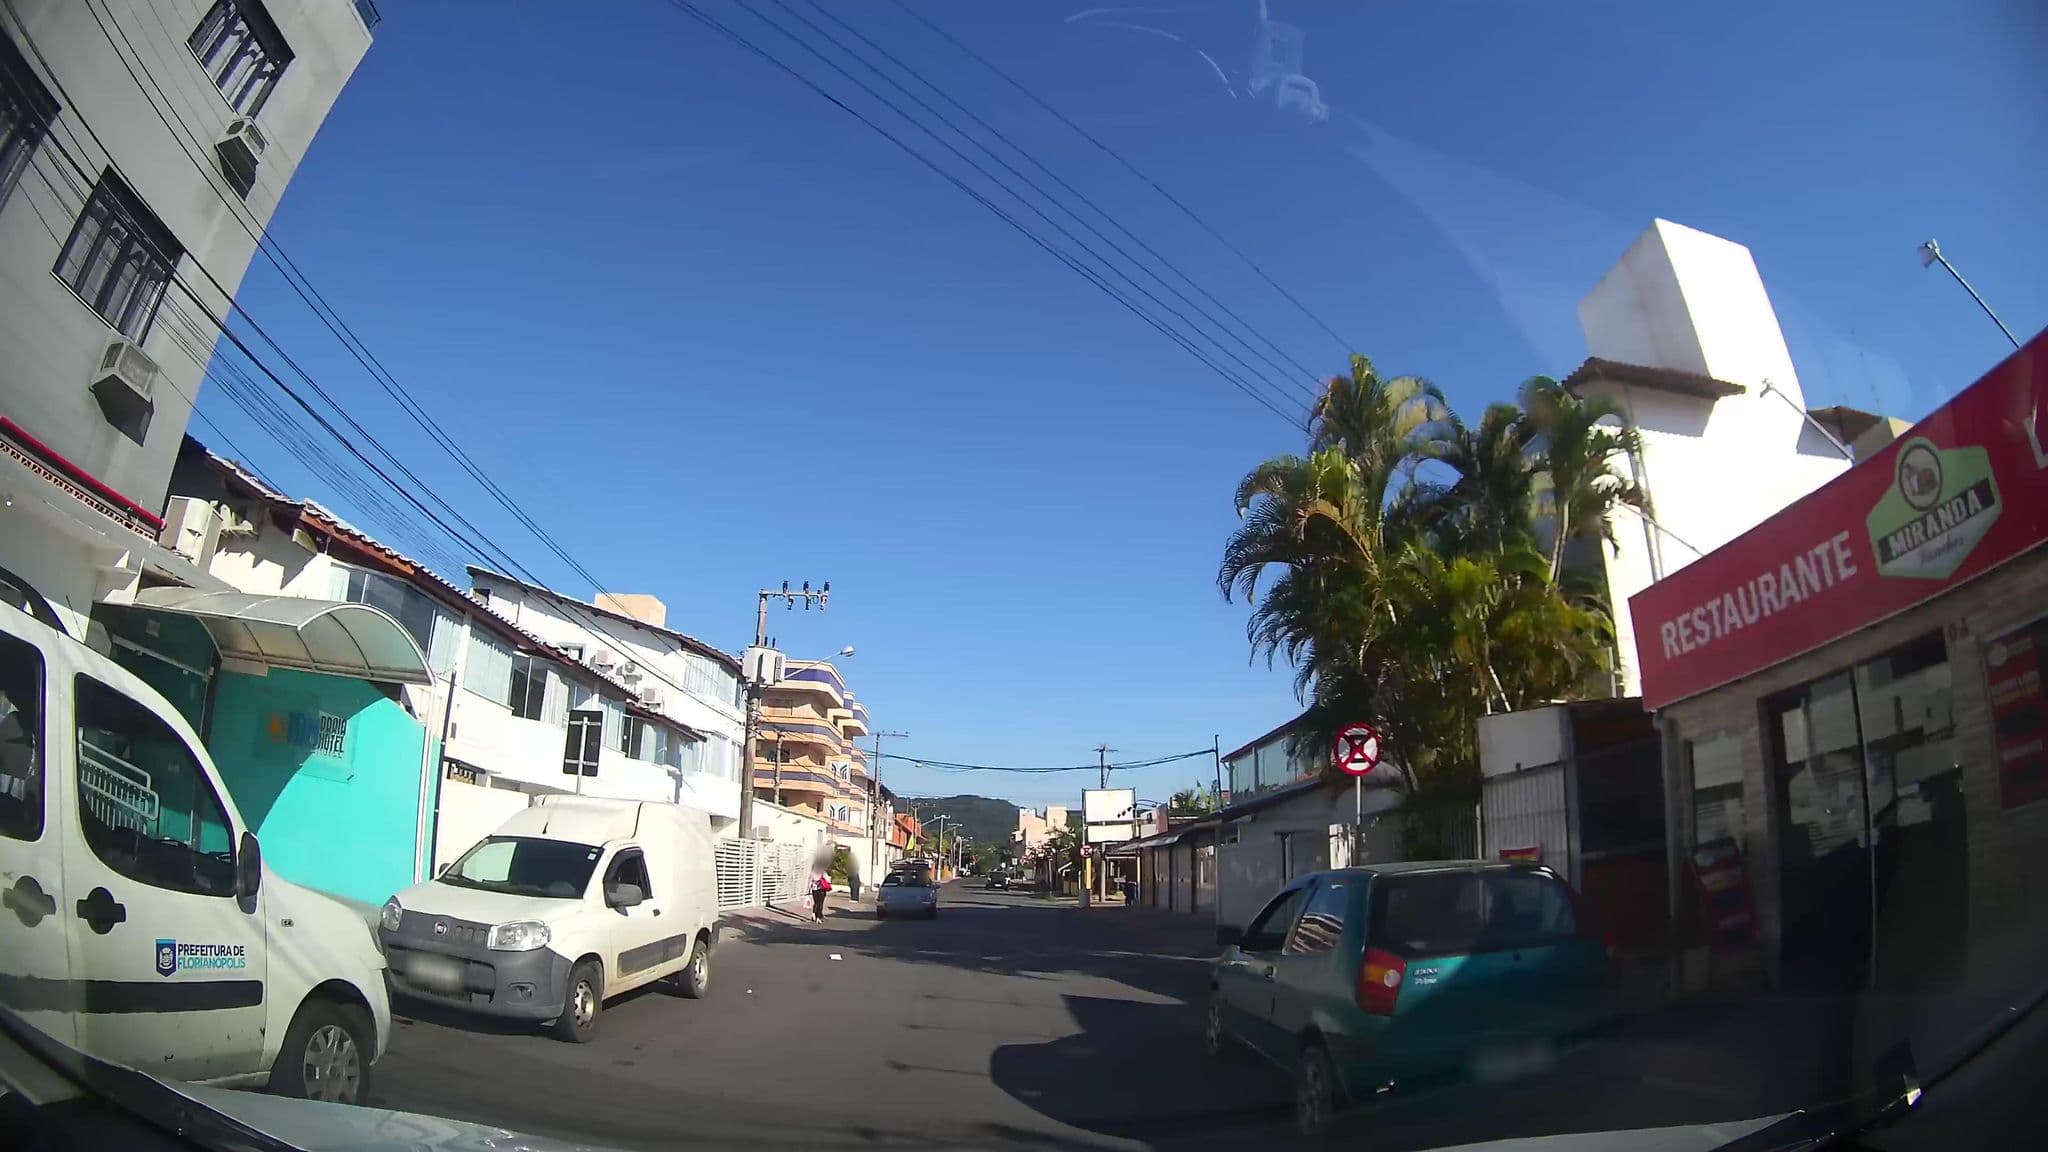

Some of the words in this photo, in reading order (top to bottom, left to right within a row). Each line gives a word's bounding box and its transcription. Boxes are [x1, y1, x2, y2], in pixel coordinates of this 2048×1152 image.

[1887, 489, 1982, 557] MIRANDA
[1660, 531, 1857, 660] RESTAURANTE
[318, 733, 345, 753] HOTEL
[177, 944, 233, 956] PREFEITURA
[234, 945, 245, 956] DE
